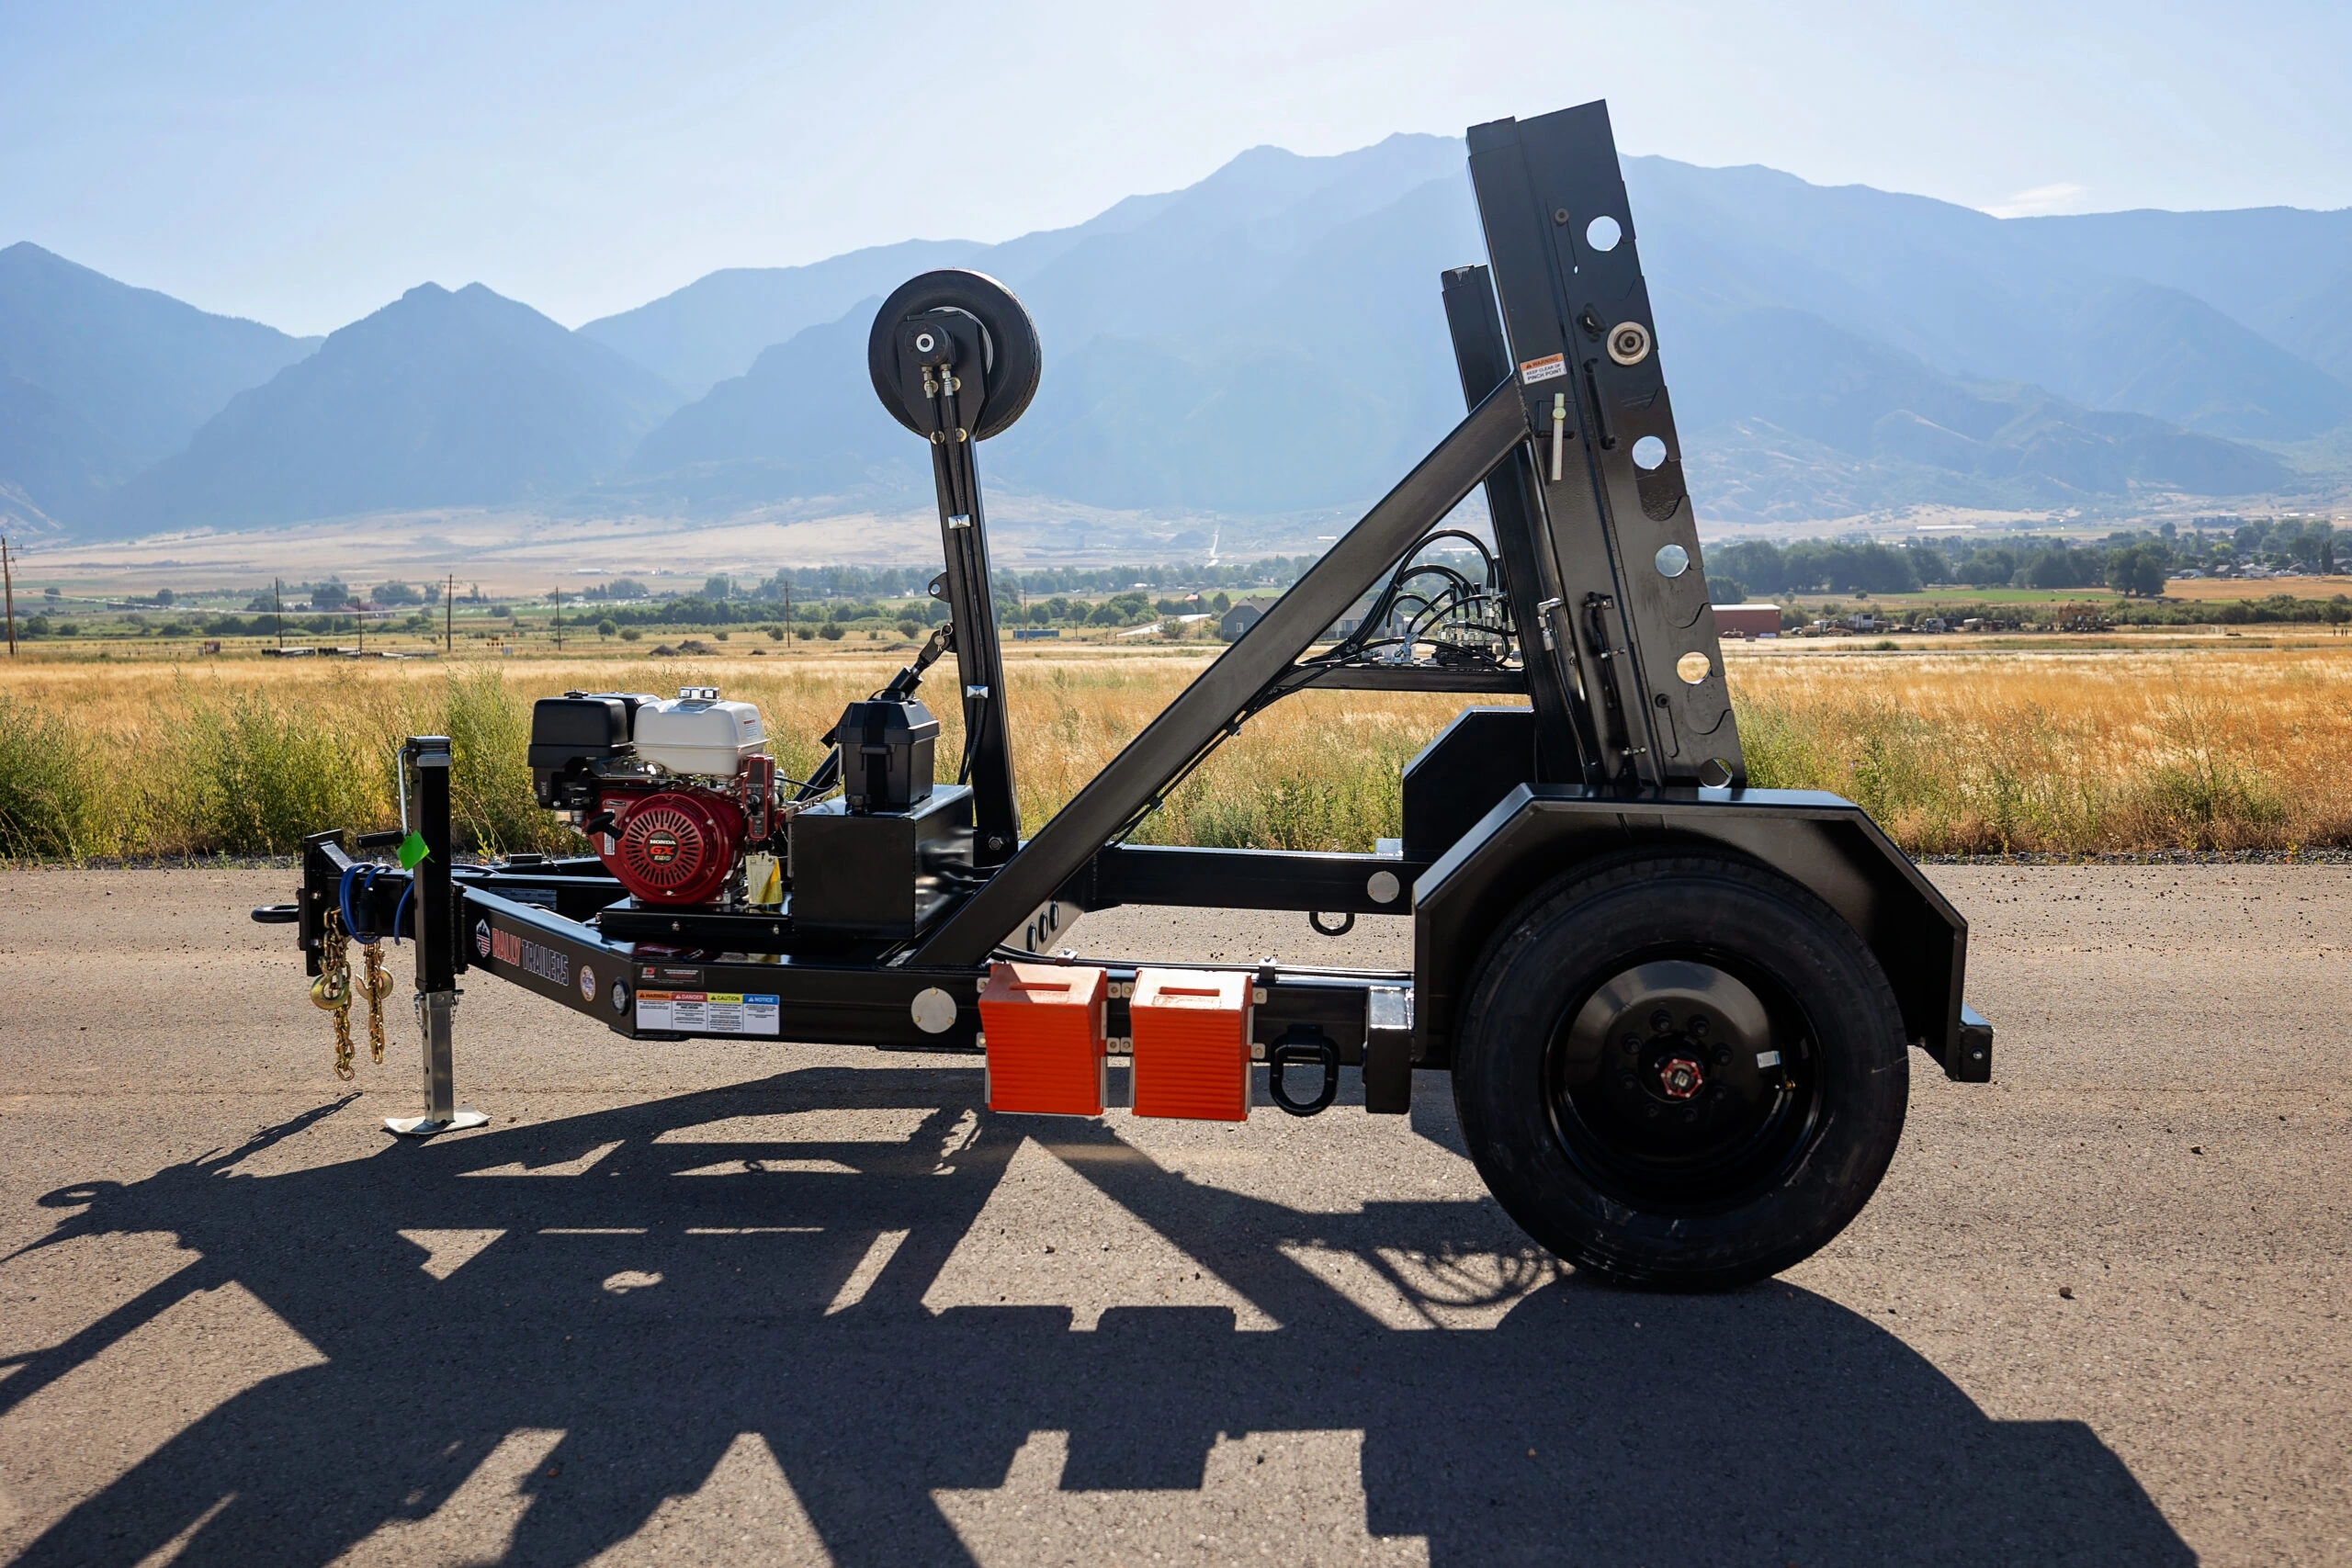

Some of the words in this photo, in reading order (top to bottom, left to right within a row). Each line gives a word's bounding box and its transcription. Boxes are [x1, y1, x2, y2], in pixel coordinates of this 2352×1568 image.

[650, 846, 675, 855] GX
[492, 928, 521, 967] RALLY
[521, 939, 570, 987] TRAILERS
